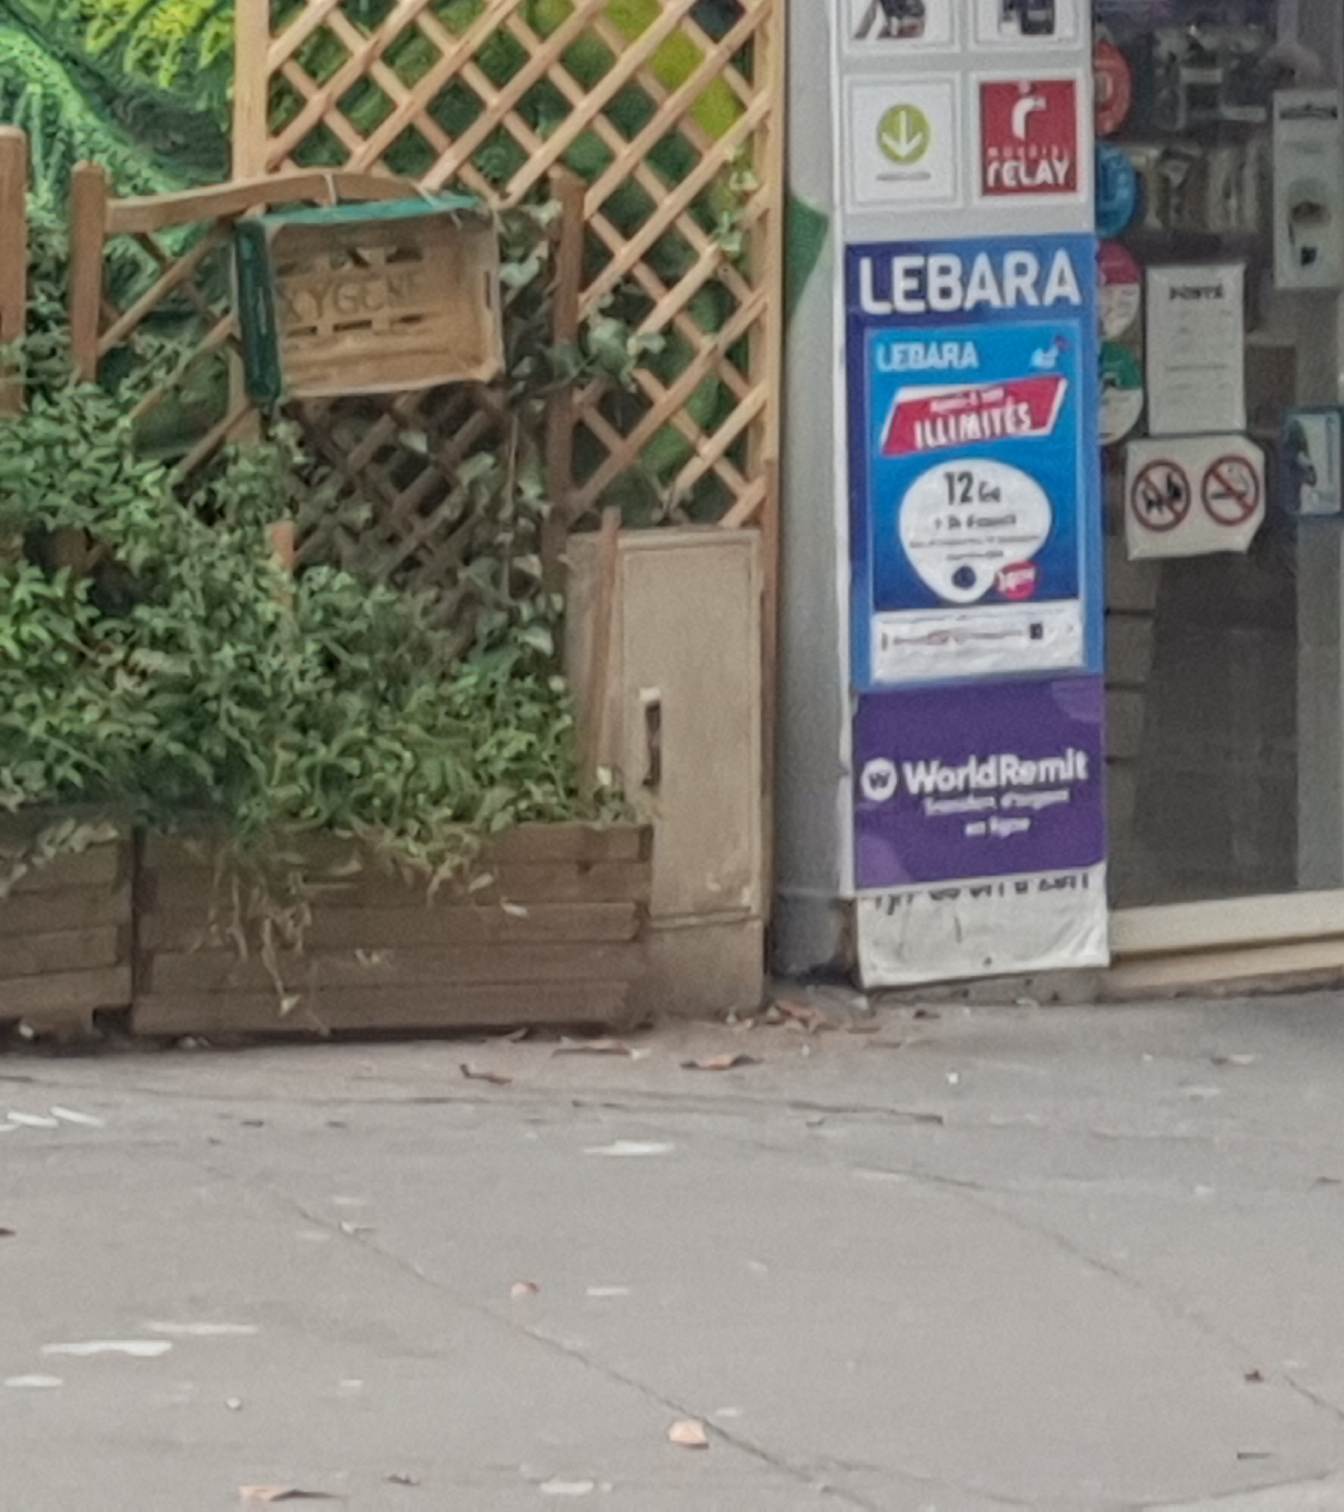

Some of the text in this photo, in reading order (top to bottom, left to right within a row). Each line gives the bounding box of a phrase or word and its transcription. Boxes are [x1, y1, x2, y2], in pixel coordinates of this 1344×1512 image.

[858, 247, 1082, 316] LEBARA
[875, 341, 980, 373] LEBARA
[914, 399, 1032, 451] ILLIMITÉS
[942, 470, 975, 507] 12
[902, 747, 1090, 796] WorldRemit
